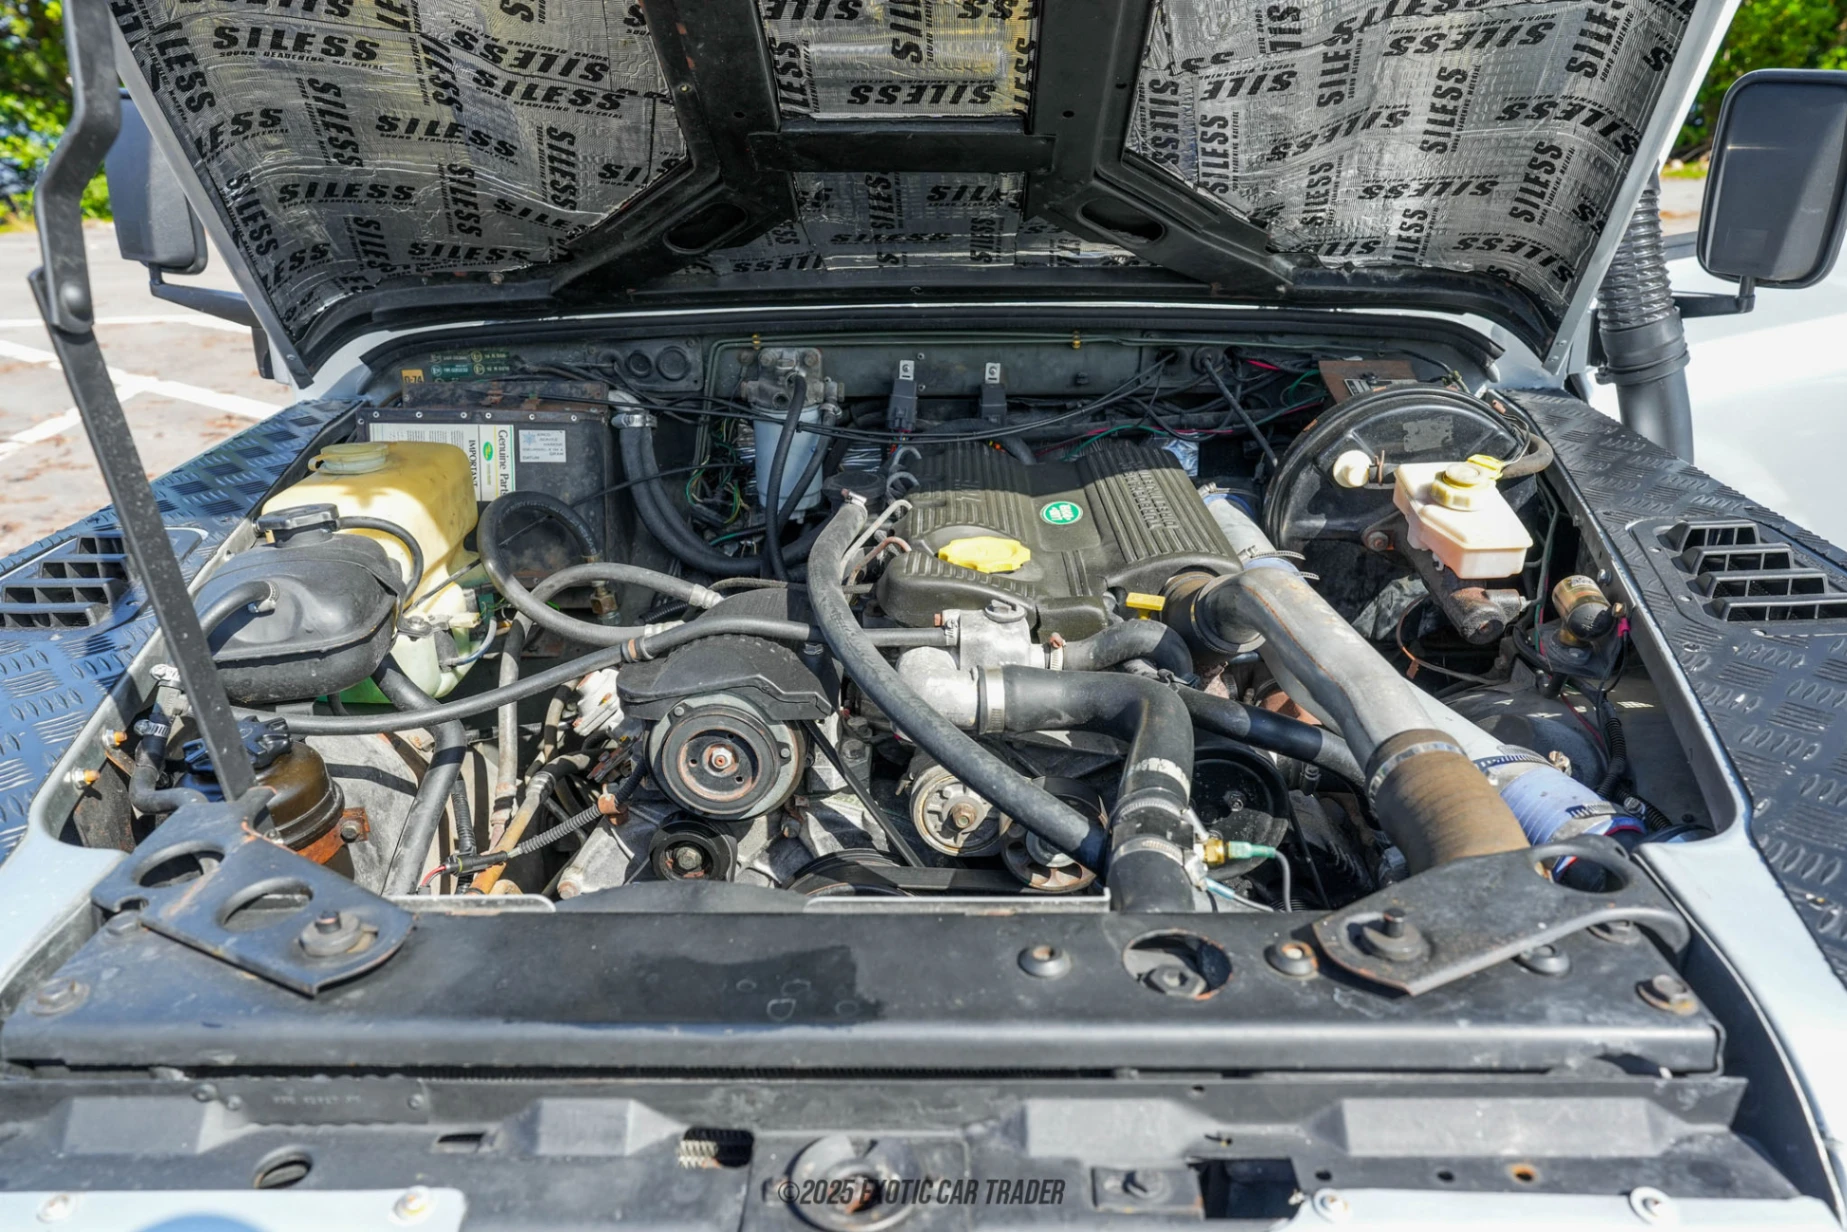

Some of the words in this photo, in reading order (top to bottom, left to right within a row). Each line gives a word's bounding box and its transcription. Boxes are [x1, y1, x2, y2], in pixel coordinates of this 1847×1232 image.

[213, 26, 379, 61] SILESS
[451, 30, 609, 82] SILESS
[1382, 22, 1556, 57] SILESS
[1599, 58, 1615, 83] SOUND
[1611, 12, 1635, 56] DEADENING
[473, 70, 626, 110] SILESS
[847, 84, 996, 105] SILESS
[1419, 66, 1468, 154] SILESS
[307, 78, 363, 167] SILESS
[375, 115, 518, 157] SILESS
[1494, 100, 1640, 155] SILESS
[546, 126, 578, 211] SILESS
[1199, 114, 1229, 194] SILESS
[278, 181, 416, 204] SILESS
[447, 163, 482, 238] SILESS
[1300, 162, 1334, 226] SILESS
[1357, 180, 1499, 200] SILESS
[1508, 141, 1563, 224] SILESS
[408, 242, 530, 261] SILESS
[1451, 237, 1575, 283] SILESS
[498, 429, 509, 470] Genuine
